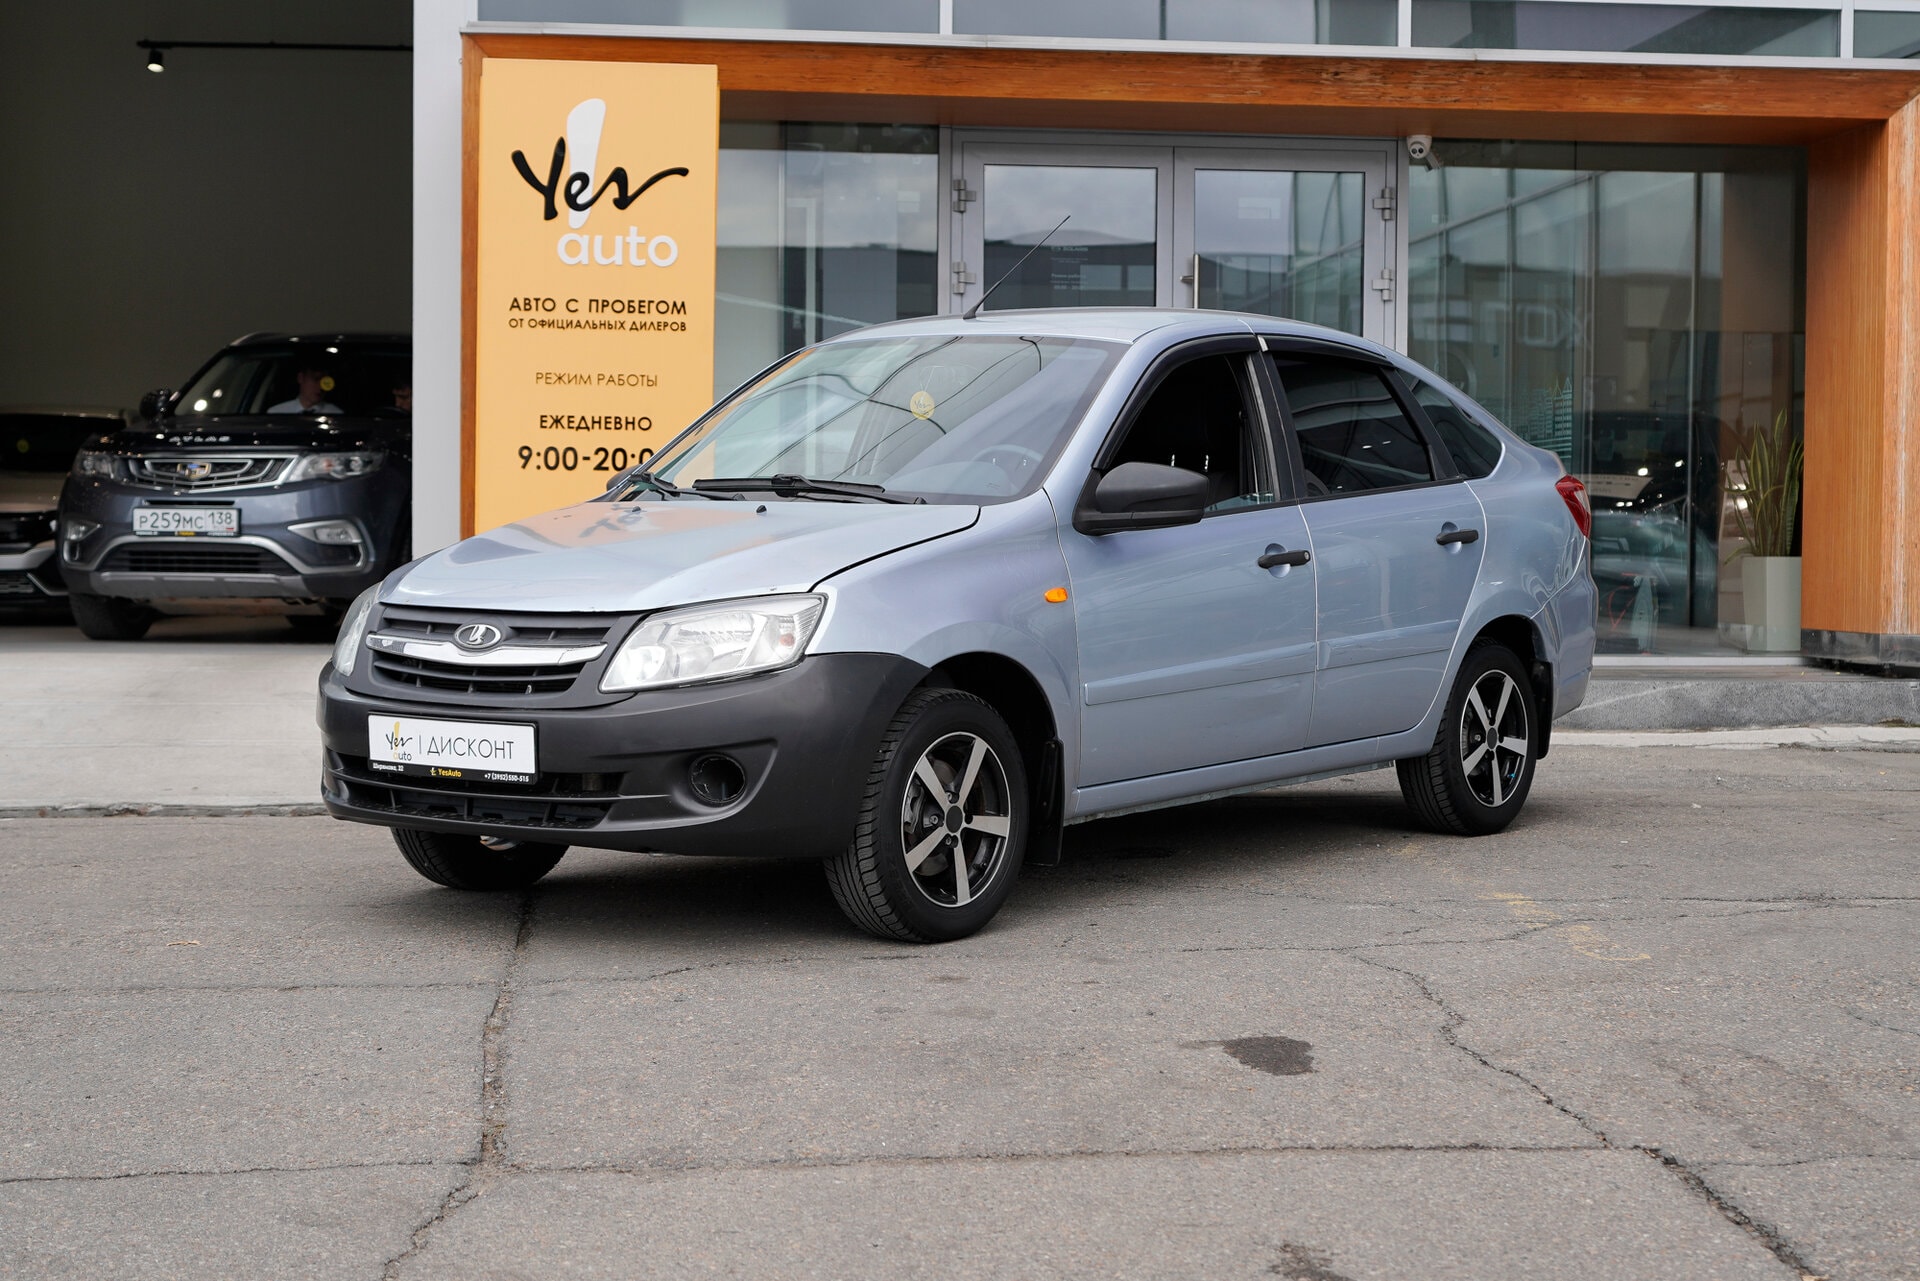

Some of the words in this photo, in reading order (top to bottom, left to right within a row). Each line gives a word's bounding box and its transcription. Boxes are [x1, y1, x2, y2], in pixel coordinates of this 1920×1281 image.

[511, 136, 689, 221] Yes
[556, 225, 679, 267] auto
[509, 297, 556, 312] АВТО
[565, 298, 579, 313] С
[588, 299, 687, 315] ПРОБЕГОМ
[508, 318, 524, 328] ОТ
[527, 318, 626, 331] ОФИЦИАЛЬНЫХ
[629, 320, 687, 332] ДИЛЕРОВ
[535, 372, 592, 385] РЕЖИМ
[597, 373, 658, 387] РАБОТЫ
[539, 414, 653, 432] ЕЖЕДНЕВНО
[518, 445, 656, 471] 9:00-20:0
[208, 511, 233, 525] 138
[393, 751, 412, 761] auto
[427, 736, 514, 760] ДИСКОНТ
[437, 768, 462, 778] YesAuto
